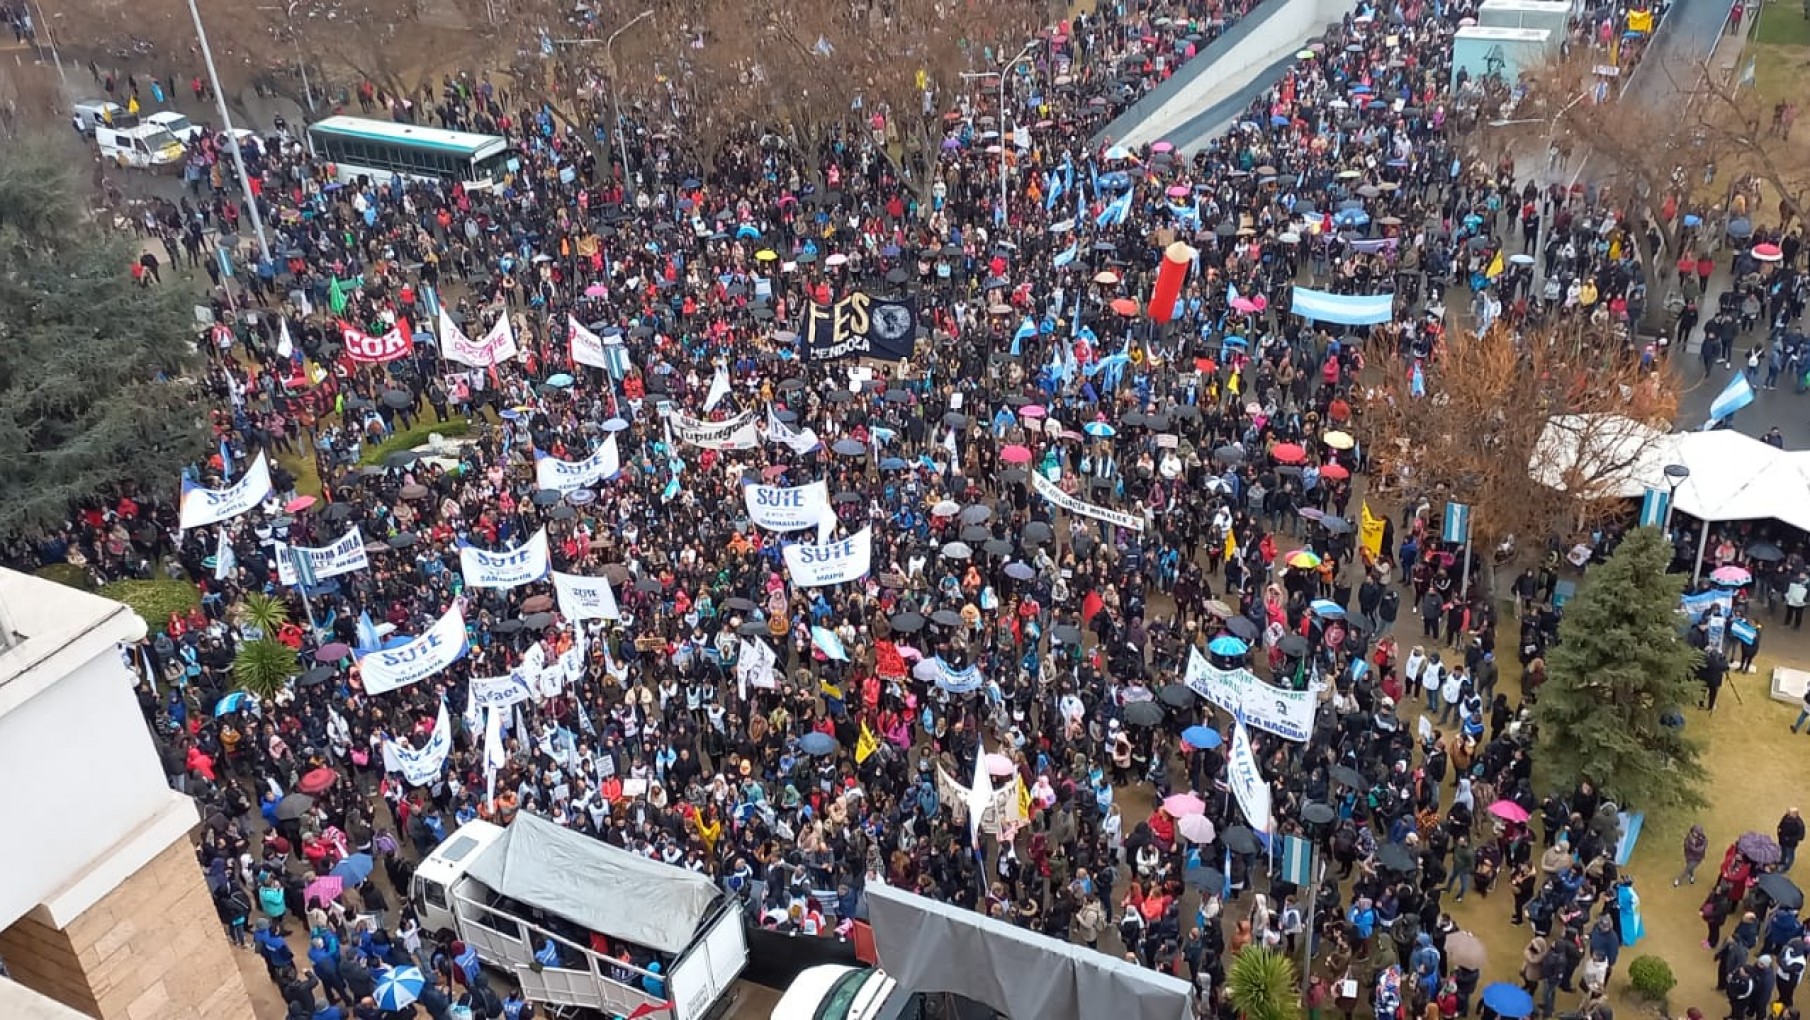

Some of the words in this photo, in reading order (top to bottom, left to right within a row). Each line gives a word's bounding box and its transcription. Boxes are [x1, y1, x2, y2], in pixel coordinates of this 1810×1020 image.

[808, 292, 869, 343] FES
[344, 328, 404, 355] COR
[810, 335, 869, 359] MENDOZA
[757, 488, 804, 507] SUTE
[338, 534, 361, 556] AULA
[801, 539, 856, 563] SUTE
[477, 549, 531, 567] SUTE
[382, 633, 442, 667] SUTE
[1191, 678, 1213, 699] AZUL
